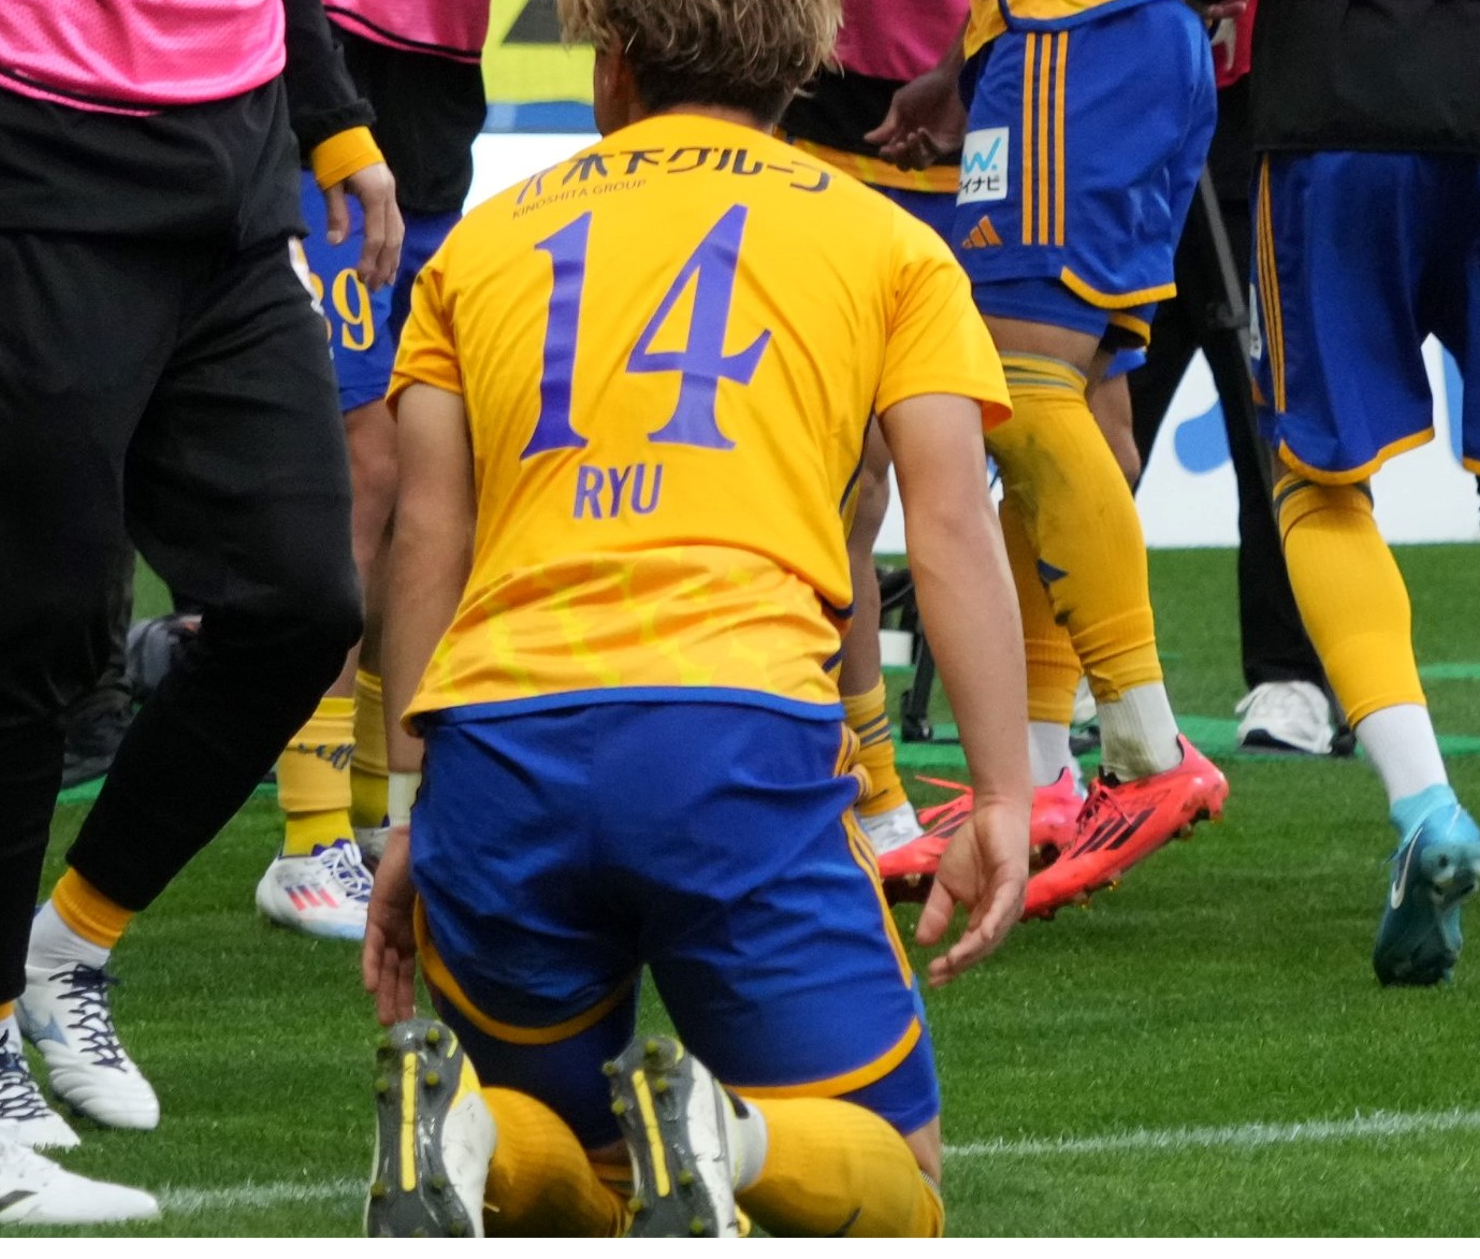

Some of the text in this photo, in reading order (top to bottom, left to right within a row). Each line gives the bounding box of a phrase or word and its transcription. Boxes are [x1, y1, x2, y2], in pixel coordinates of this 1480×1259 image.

[512, 178, 648, 220] KINOSHITA GROUP
[959, 175, 1001, 195] イナビ
[520, 203, 773, 461] 14
[571, 463, 664, 520] RYU
